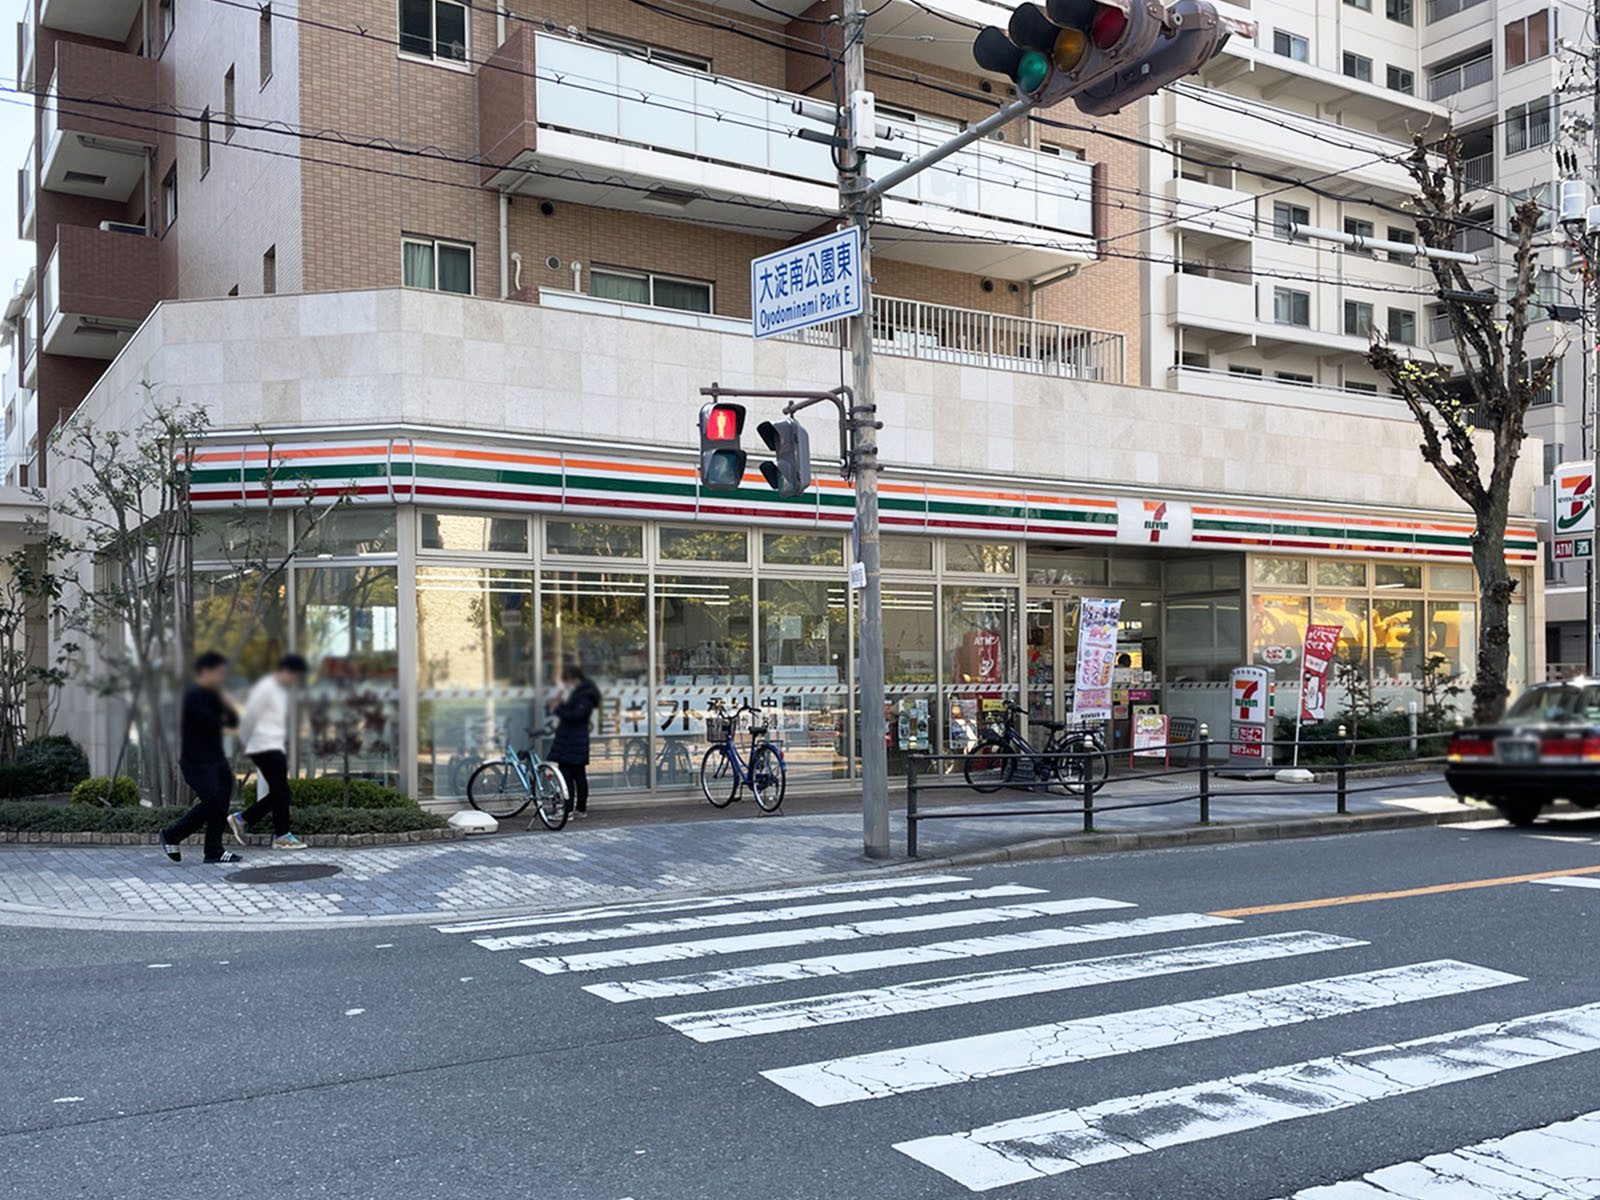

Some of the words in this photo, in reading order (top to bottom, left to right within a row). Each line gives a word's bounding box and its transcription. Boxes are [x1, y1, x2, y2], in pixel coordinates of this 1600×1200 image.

[760, 242, 852, 303] 大淀南公園東
[760, 295, 818, 330] Oyodominami
[820, 289, 841, 312] Park
[1555, 542, 1572, 556] ATM
[1235, 680, 1258, 719] 7
